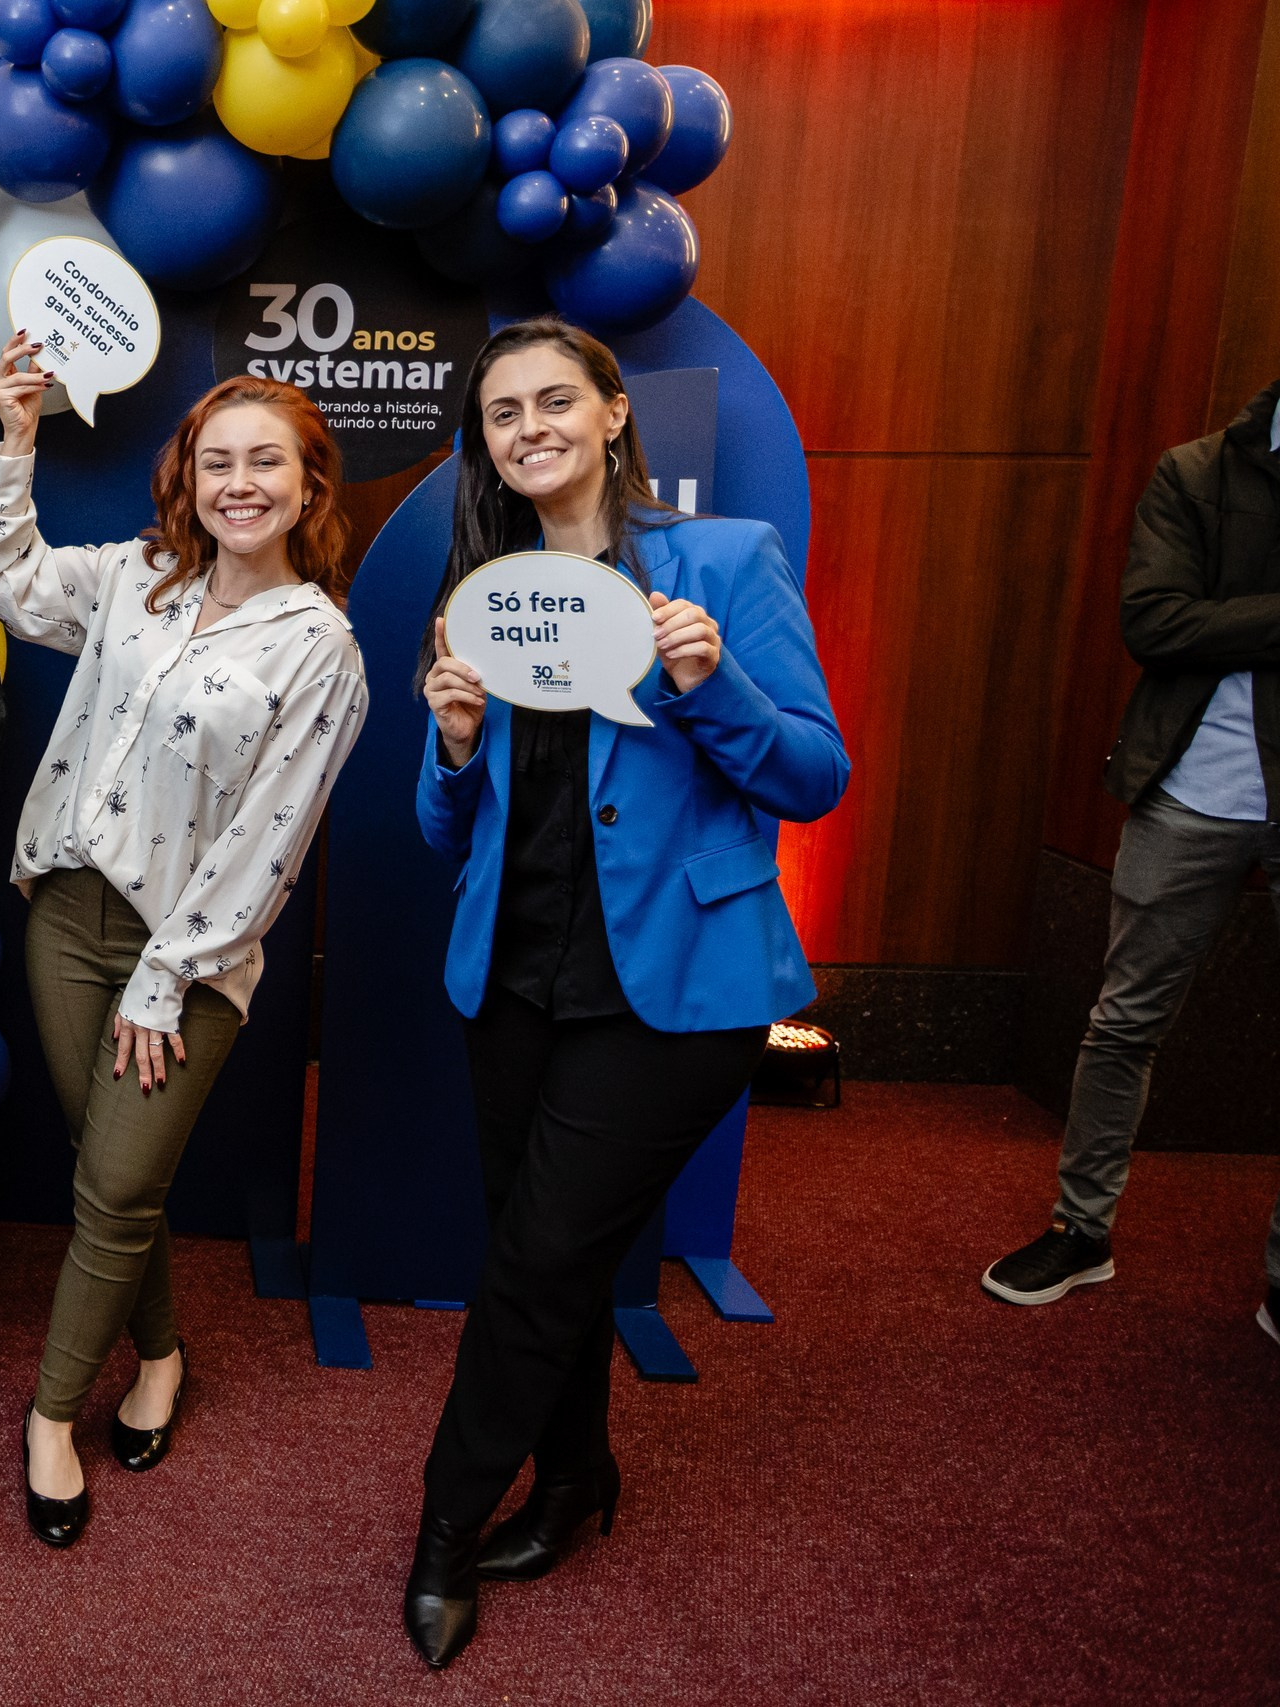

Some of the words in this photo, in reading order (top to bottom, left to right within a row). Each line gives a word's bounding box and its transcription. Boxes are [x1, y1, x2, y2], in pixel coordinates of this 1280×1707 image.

[64, 260, 139, 331] Condomínio
[45, 269, 82, 309] unido,
[84, 305, 136, 353] sucesso
[244, 282, 354, 352] 30
[353, 330, 436, 351] anos
[45, 295, 113, 356] garantido!
[48, 329, 65, 346] 30
[313, 400, 370, 413] brando
[373, 403, 382, 414] a
[386, 401, 442, 417] história,
[325, 416, 375, 429] ruindo
[378, 419, 388, 429] o
[391, 417, 436, 430] futuro
[487, 591, 521, 613] Só
[529, 591, 585, 613] fera
[490, 620, 559, 647] aqui!
[531, 665, 553, 679] 30
[532, 679, 572, 689] systemar
